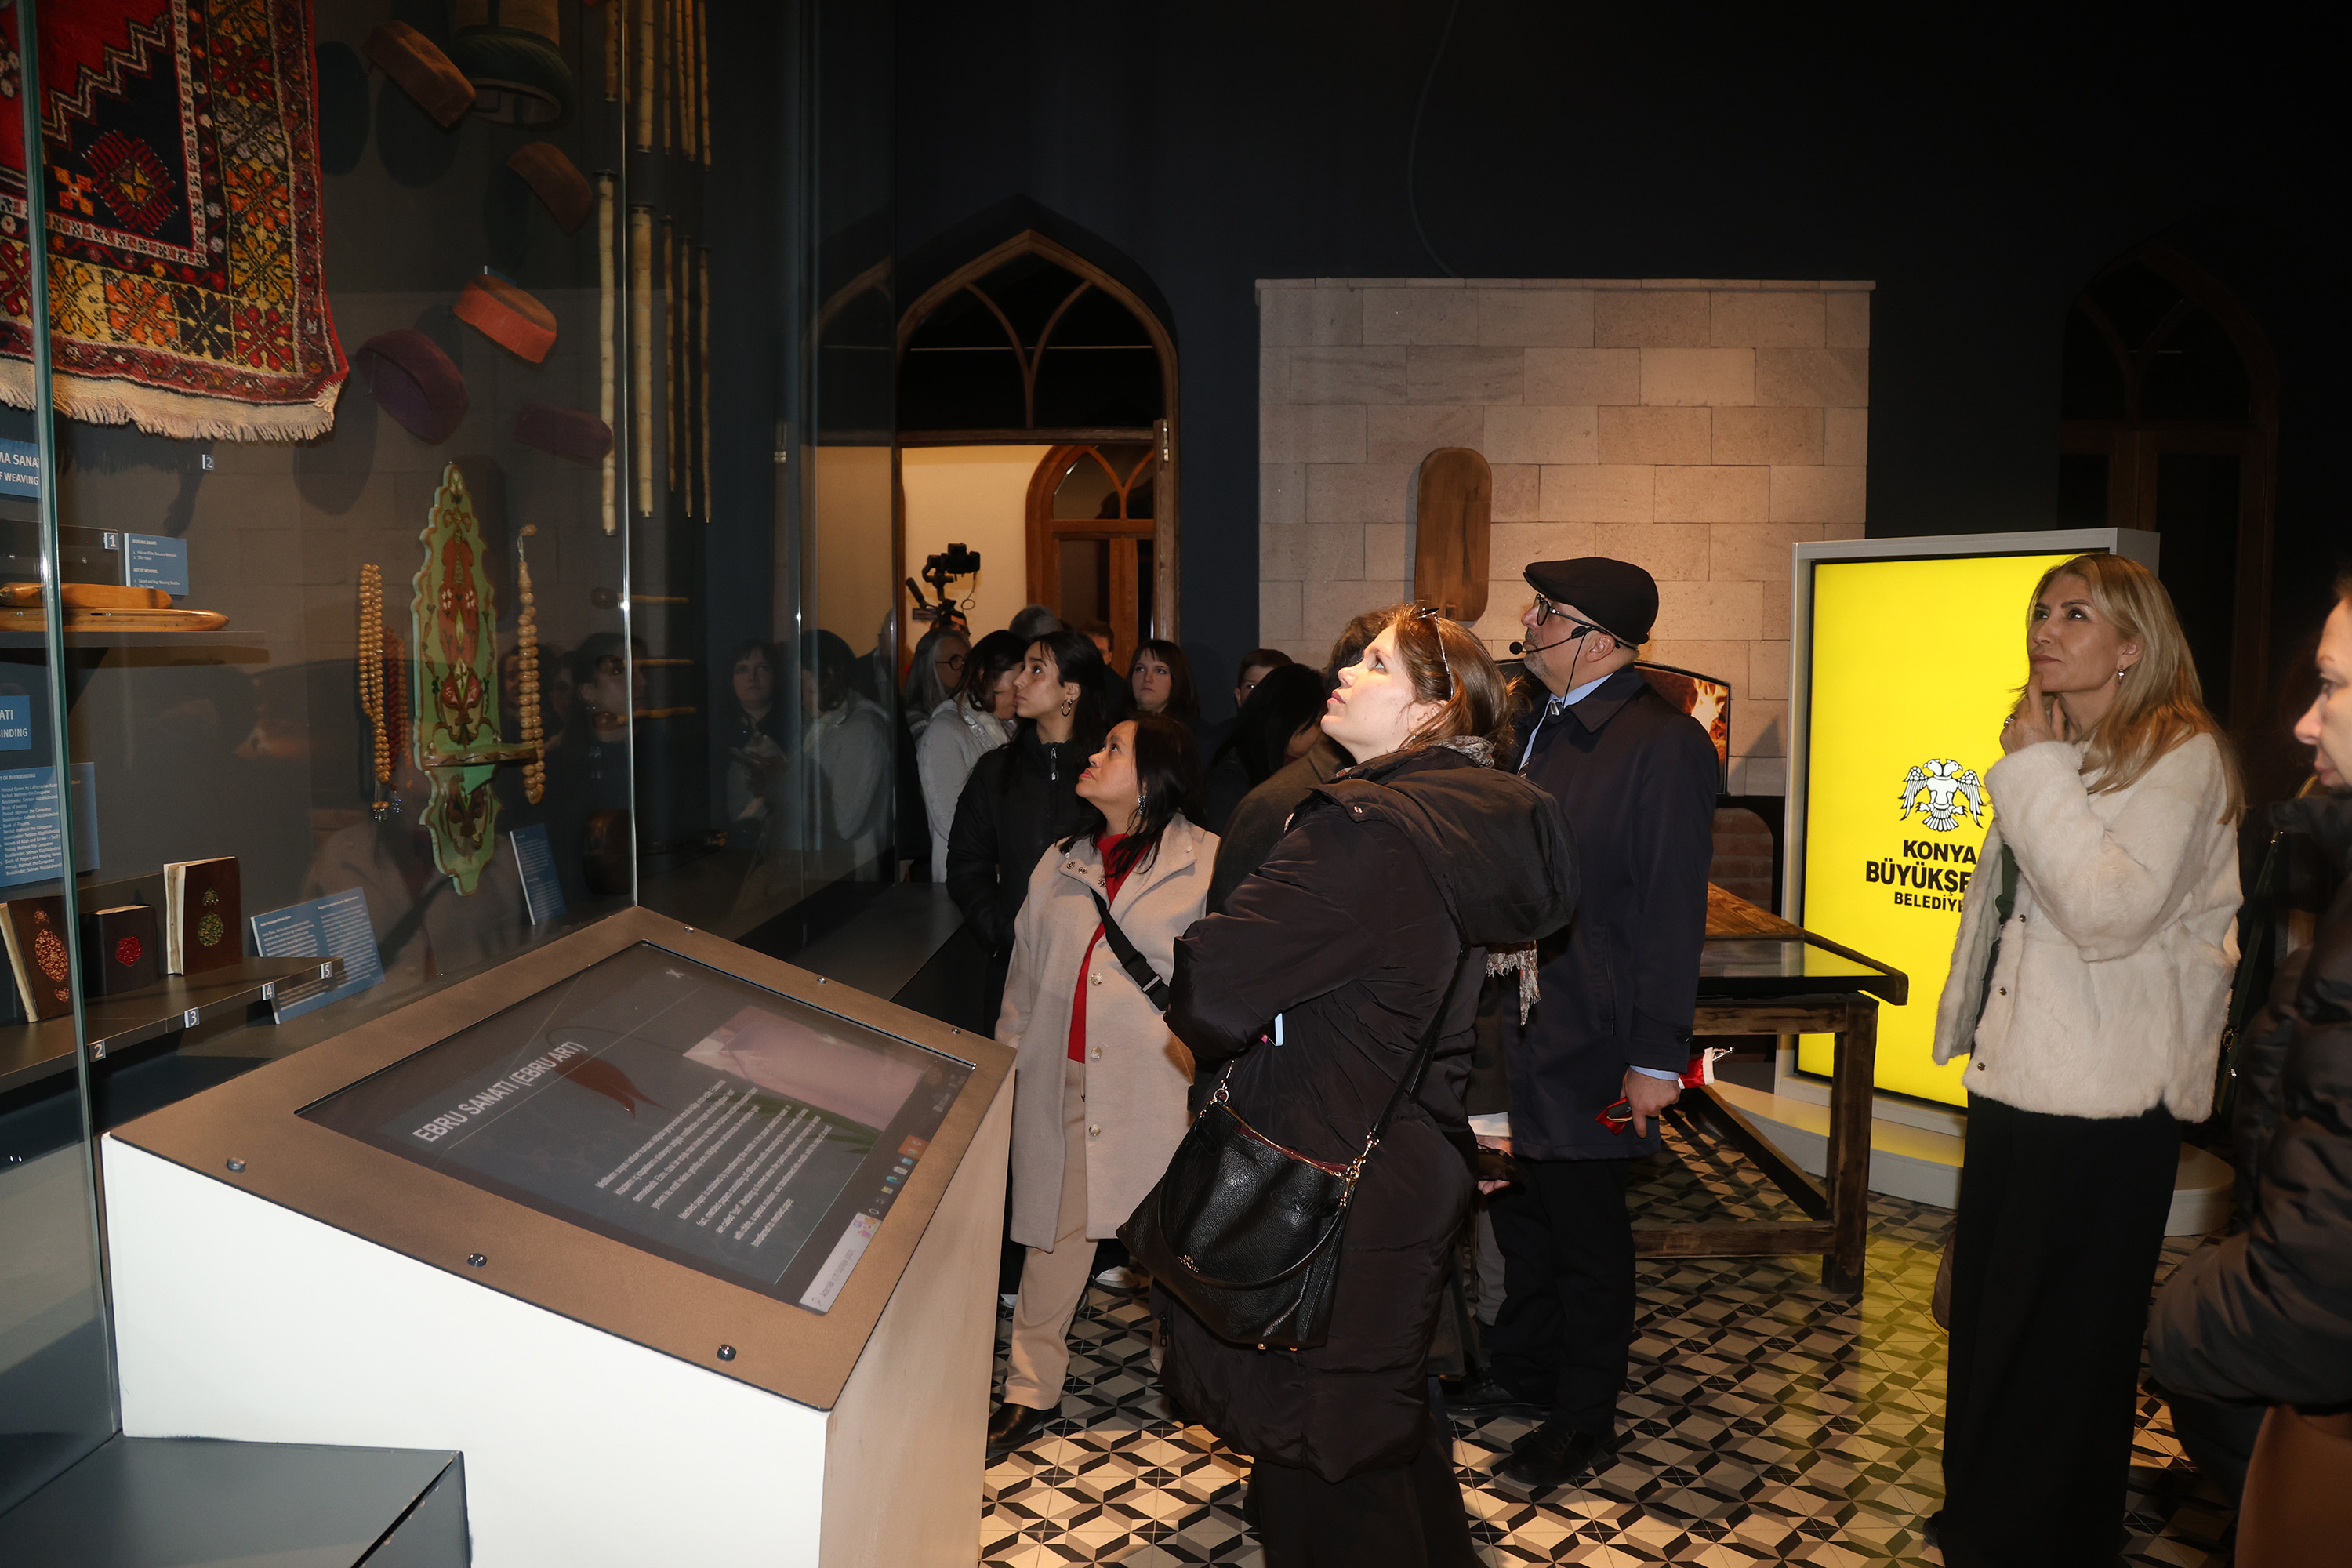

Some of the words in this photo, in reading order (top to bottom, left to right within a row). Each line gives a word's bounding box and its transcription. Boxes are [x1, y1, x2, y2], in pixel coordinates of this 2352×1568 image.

[206, 456, 212, 469] 2
[4, 472, 39, 485] WEAVING
[109, 535, 116, 547] 1
[1903, 840, 1977, 864] KONYA
[325, 965, 330, 976] 5
[267, 986, 272, 997] 4
[189, 1011, 197, 1025] 3
[94, 1044, 104, 1058] 2
[412, 1110, 468, 1142] EBRU
[458, 1076, 515, 1114] SANATI
[509, 1057, 557, 1086] (EBRU
[548, 1041, 588, 1062] ART)
